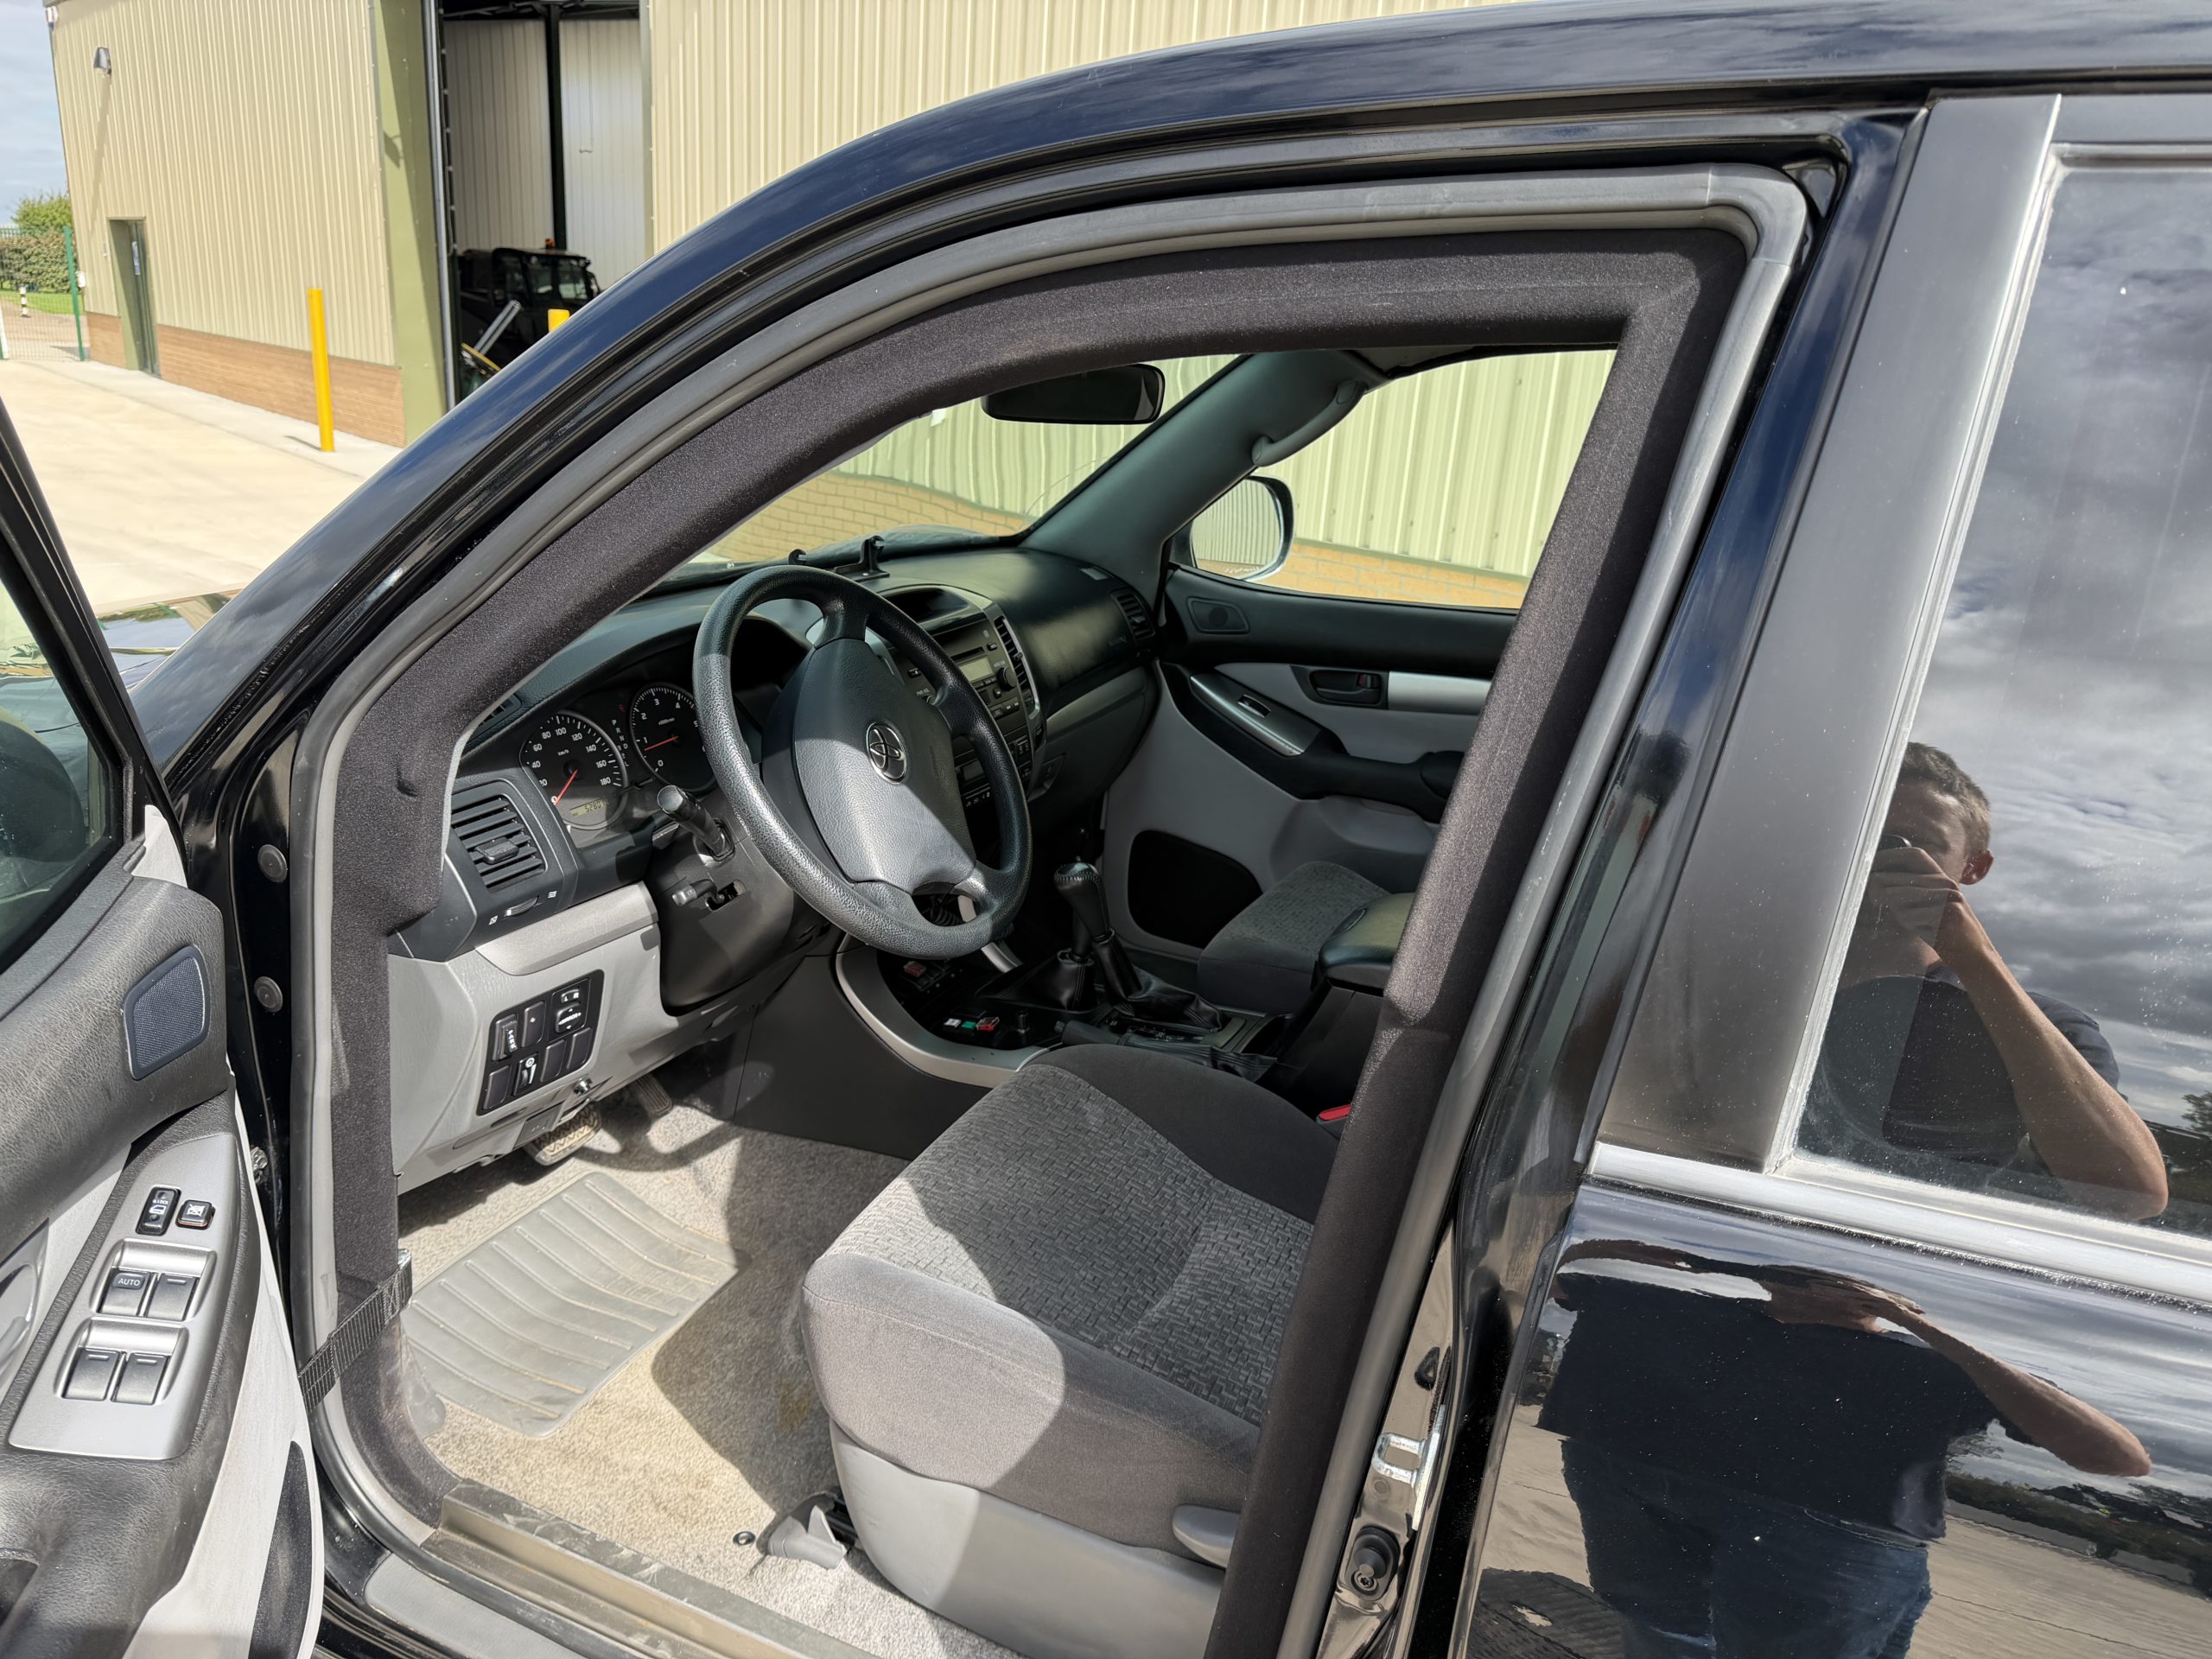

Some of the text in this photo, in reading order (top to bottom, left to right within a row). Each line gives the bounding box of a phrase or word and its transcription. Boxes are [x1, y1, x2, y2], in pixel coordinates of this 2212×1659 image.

[555, 727, 566, 736] 100
[572, 733, 583, 741] 120
[586, 744, 597, 753] 140
[596, 760, 607, 768] 160
[600, 777, 611, 786] 180
